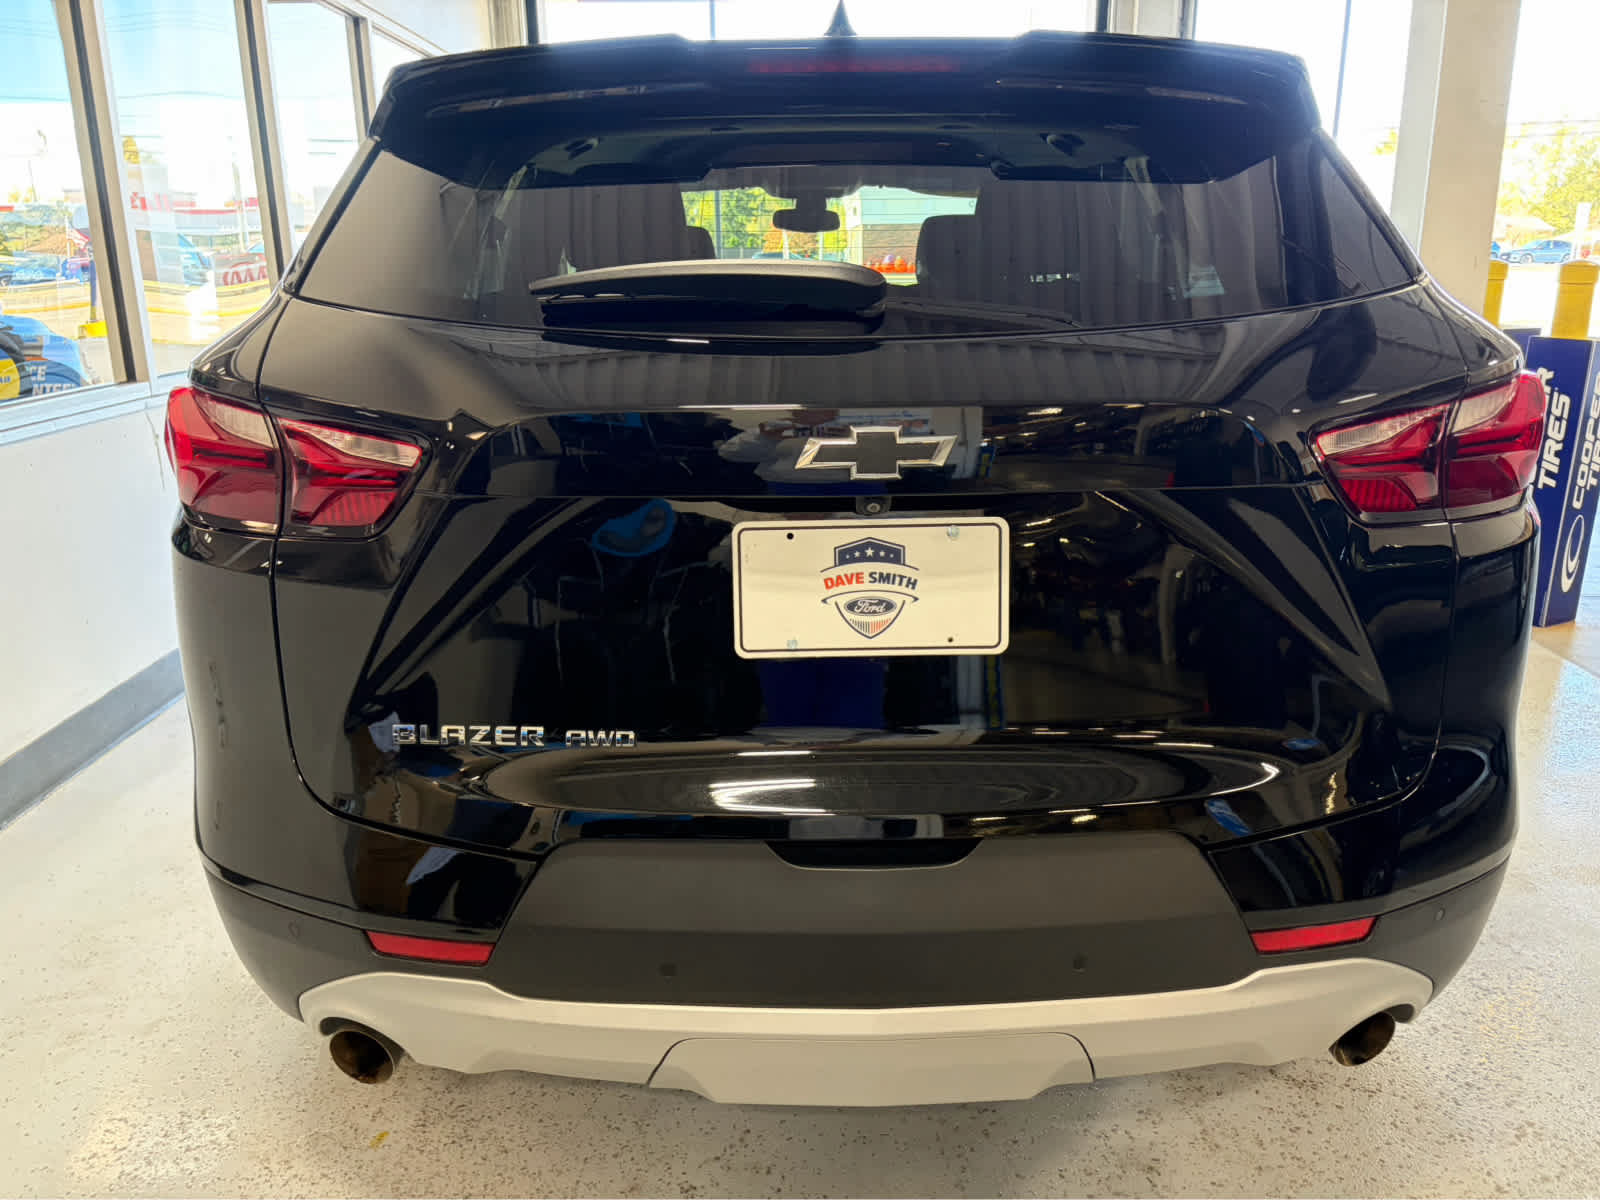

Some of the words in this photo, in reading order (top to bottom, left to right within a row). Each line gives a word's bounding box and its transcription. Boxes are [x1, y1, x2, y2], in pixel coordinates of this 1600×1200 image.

[1537, 391, 1571, 489] TIRES
[824, 572, 865, 590] DAVE
[868, 571, 918, 590] SMITH
[854, 599, 887, 613] Ford
[392, 723, 545, 747] BLAZER
[565, 730, 636, 748] AWD
